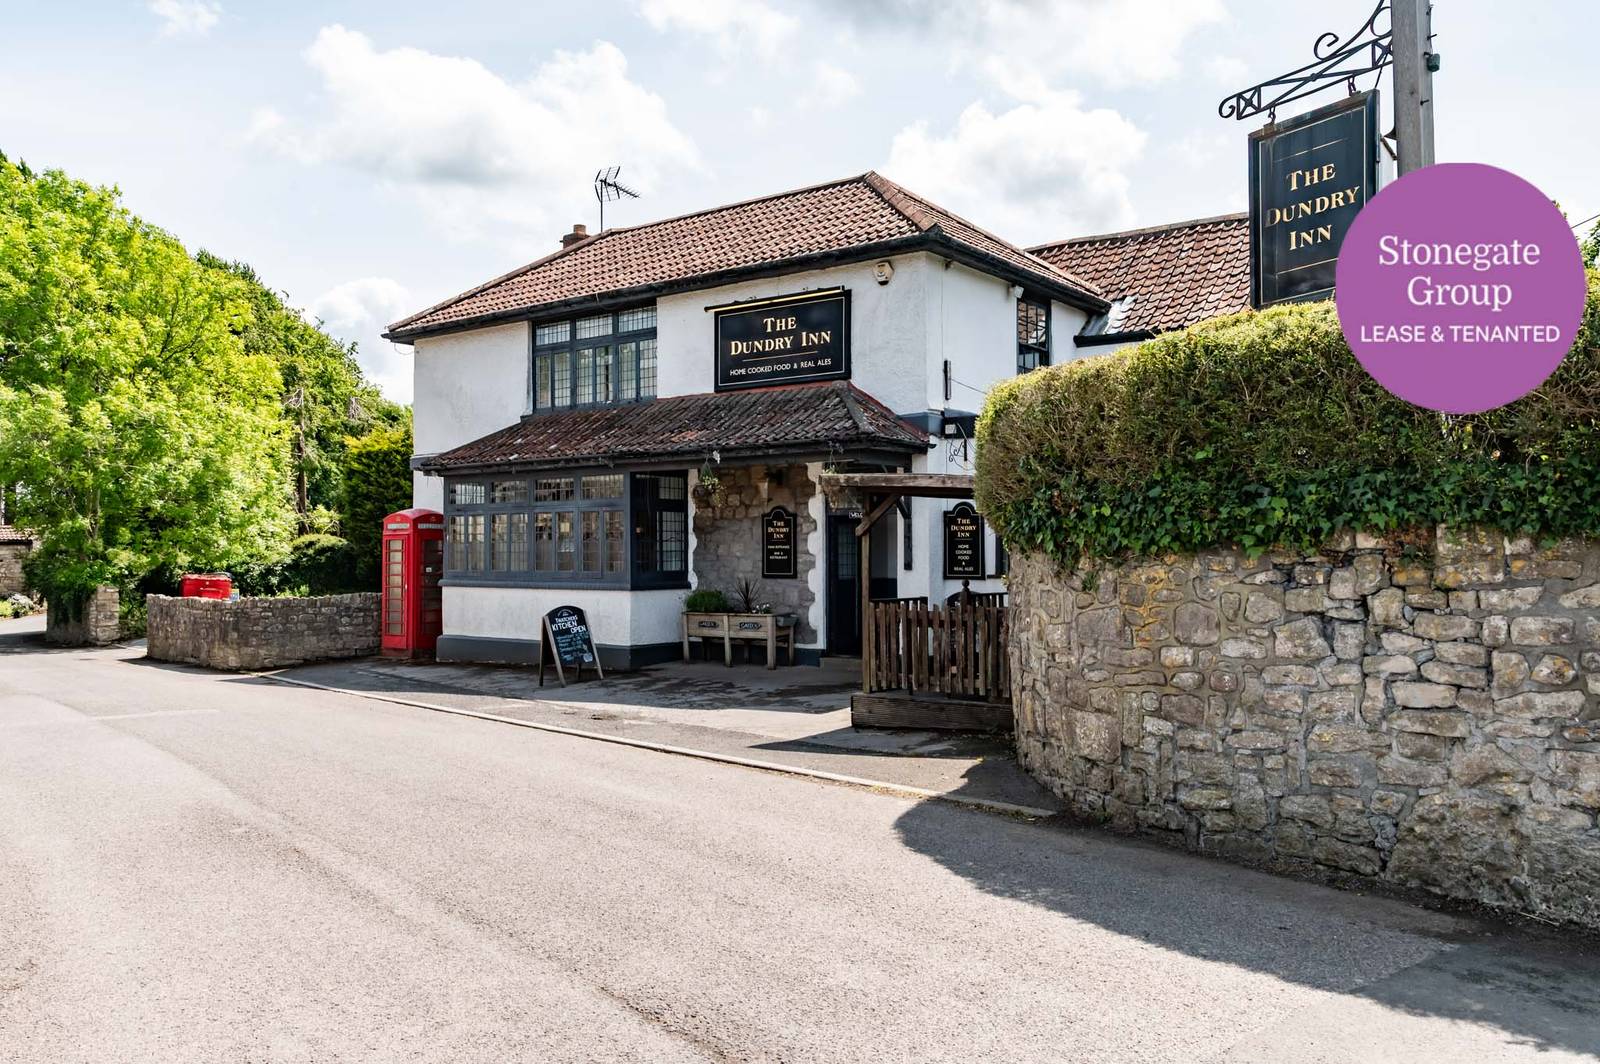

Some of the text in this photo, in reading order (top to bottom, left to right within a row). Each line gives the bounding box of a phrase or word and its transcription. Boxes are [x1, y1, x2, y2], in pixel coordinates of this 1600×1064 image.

[1286, 163, 1336, 192] THE
[1265, 185, 1360, 228] DUNDRY
[1289, 224, 1333, 251] INN
[763, 316, 797, 333] THE
[730, 330, 831, 356] DUNDRY INN
[729, 367, 746, 377] HOME
[747, 365, 773, 375] COOKED
[773, 363, 791, 372] FOOD
[800, 360, 815, 368] REAL
[817, 358, 832, 367] ALES
[956, 517, 971, 525] THE
[551, 620, 578, 632] KITCHEN
[570, 625, 587, 634] OPEN
